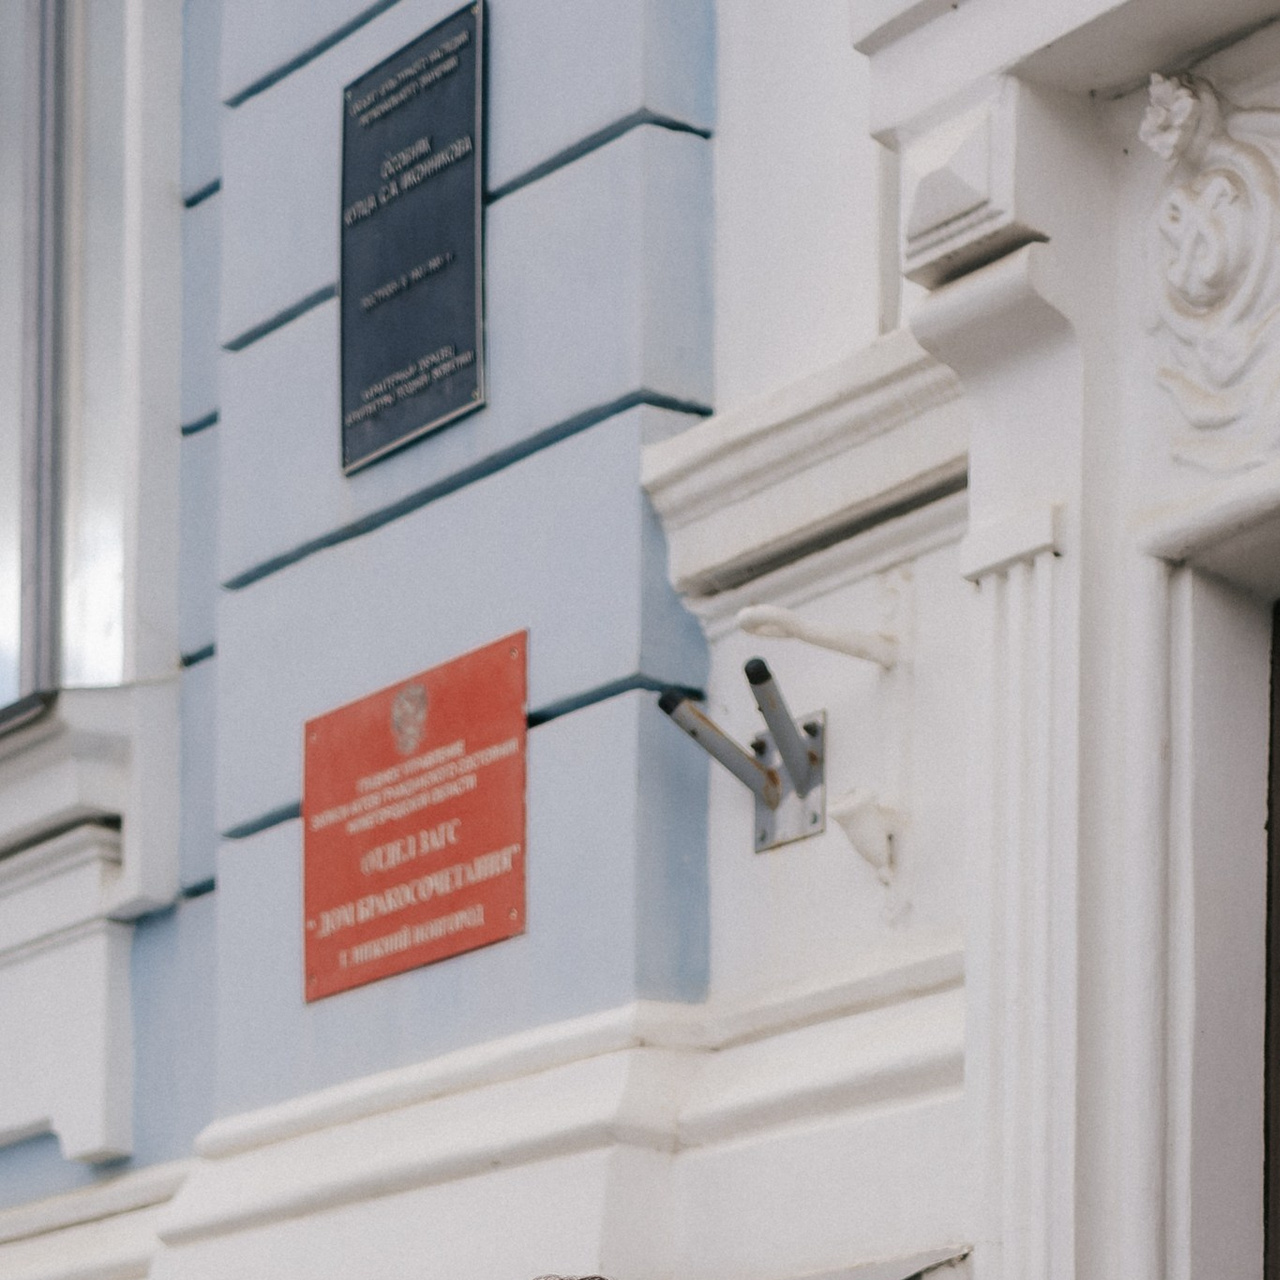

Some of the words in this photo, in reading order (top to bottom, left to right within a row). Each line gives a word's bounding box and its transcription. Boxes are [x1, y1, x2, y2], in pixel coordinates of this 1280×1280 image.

[361, 837, 415, 875] ОТДЕЛ
[419, 818, 460, 853] ЗАГС
[352, 922, 411, 965] НИЖНИЙ
[412, 903, 484, 946] НОВГОРОД
